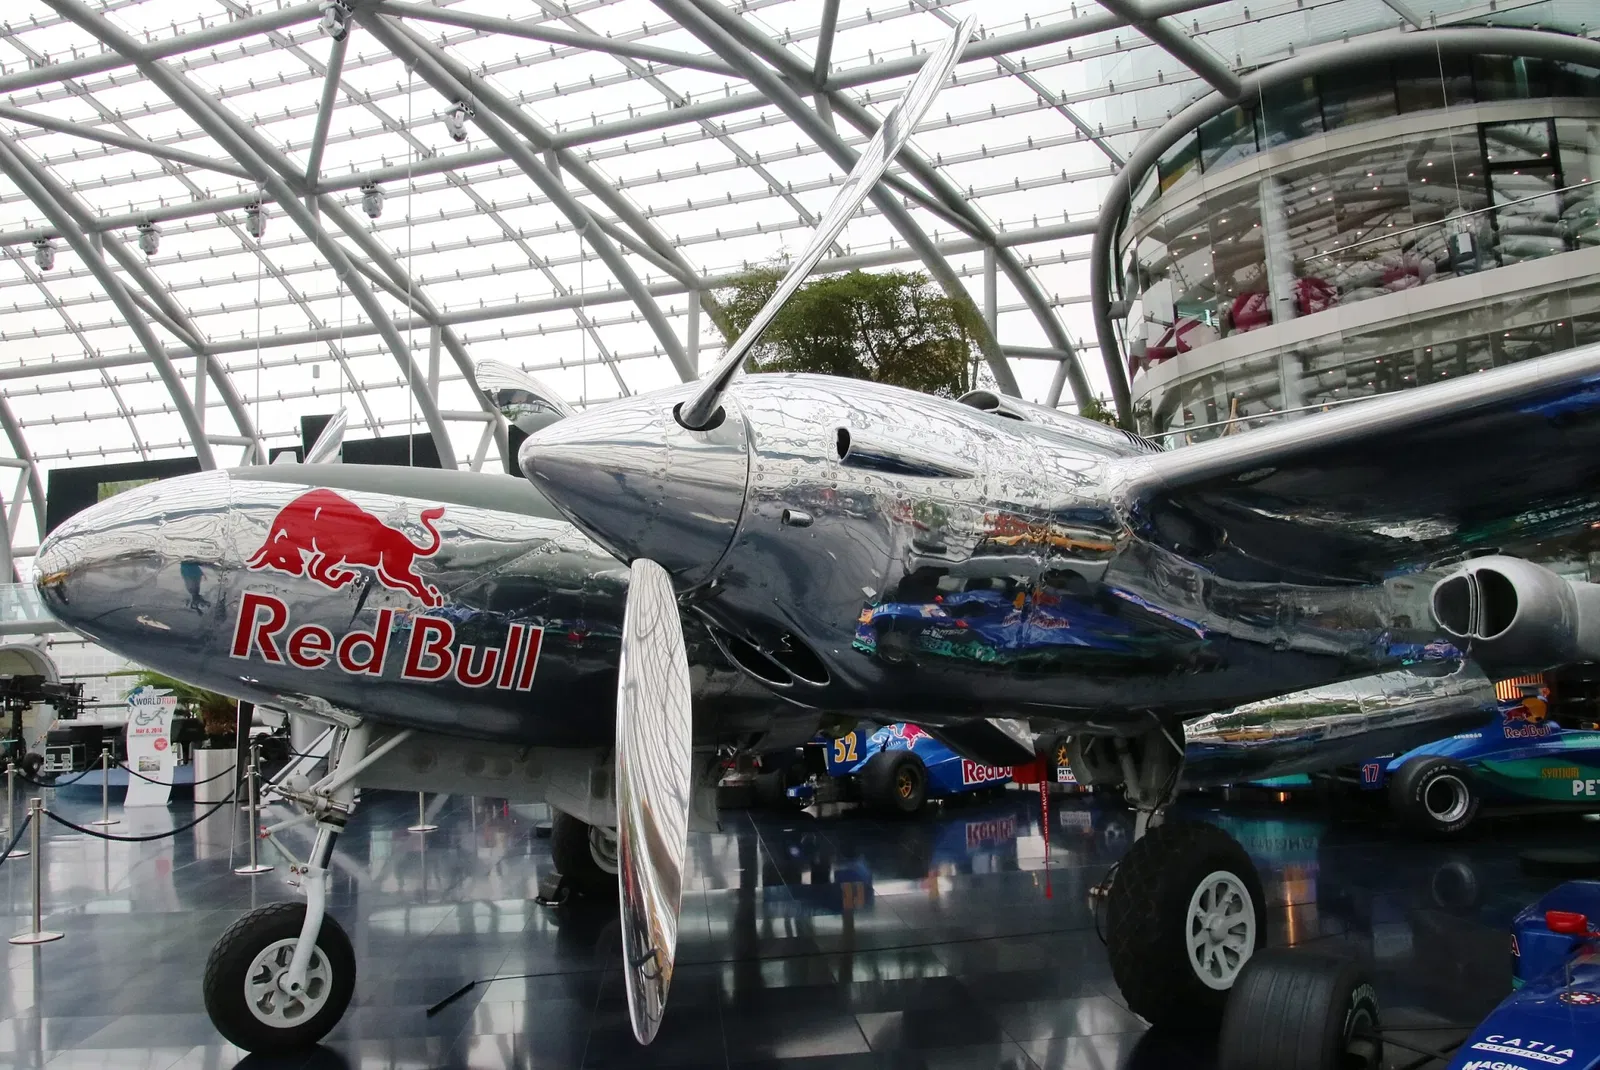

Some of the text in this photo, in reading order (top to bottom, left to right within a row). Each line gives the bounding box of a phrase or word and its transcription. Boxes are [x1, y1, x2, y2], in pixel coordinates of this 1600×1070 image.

[230, 590, 544, 692] Red Bull
[136, 697, 161, 706] WORLD
[1503, 725, 1529, 739] Red
[834, 731, 858, 763] 52
[1362, 763, 1379, 783] 17
[1476, 1044, 1561, 1063] SOLUTIONS
[1485, 1035, 1574, 1058] CATIA
